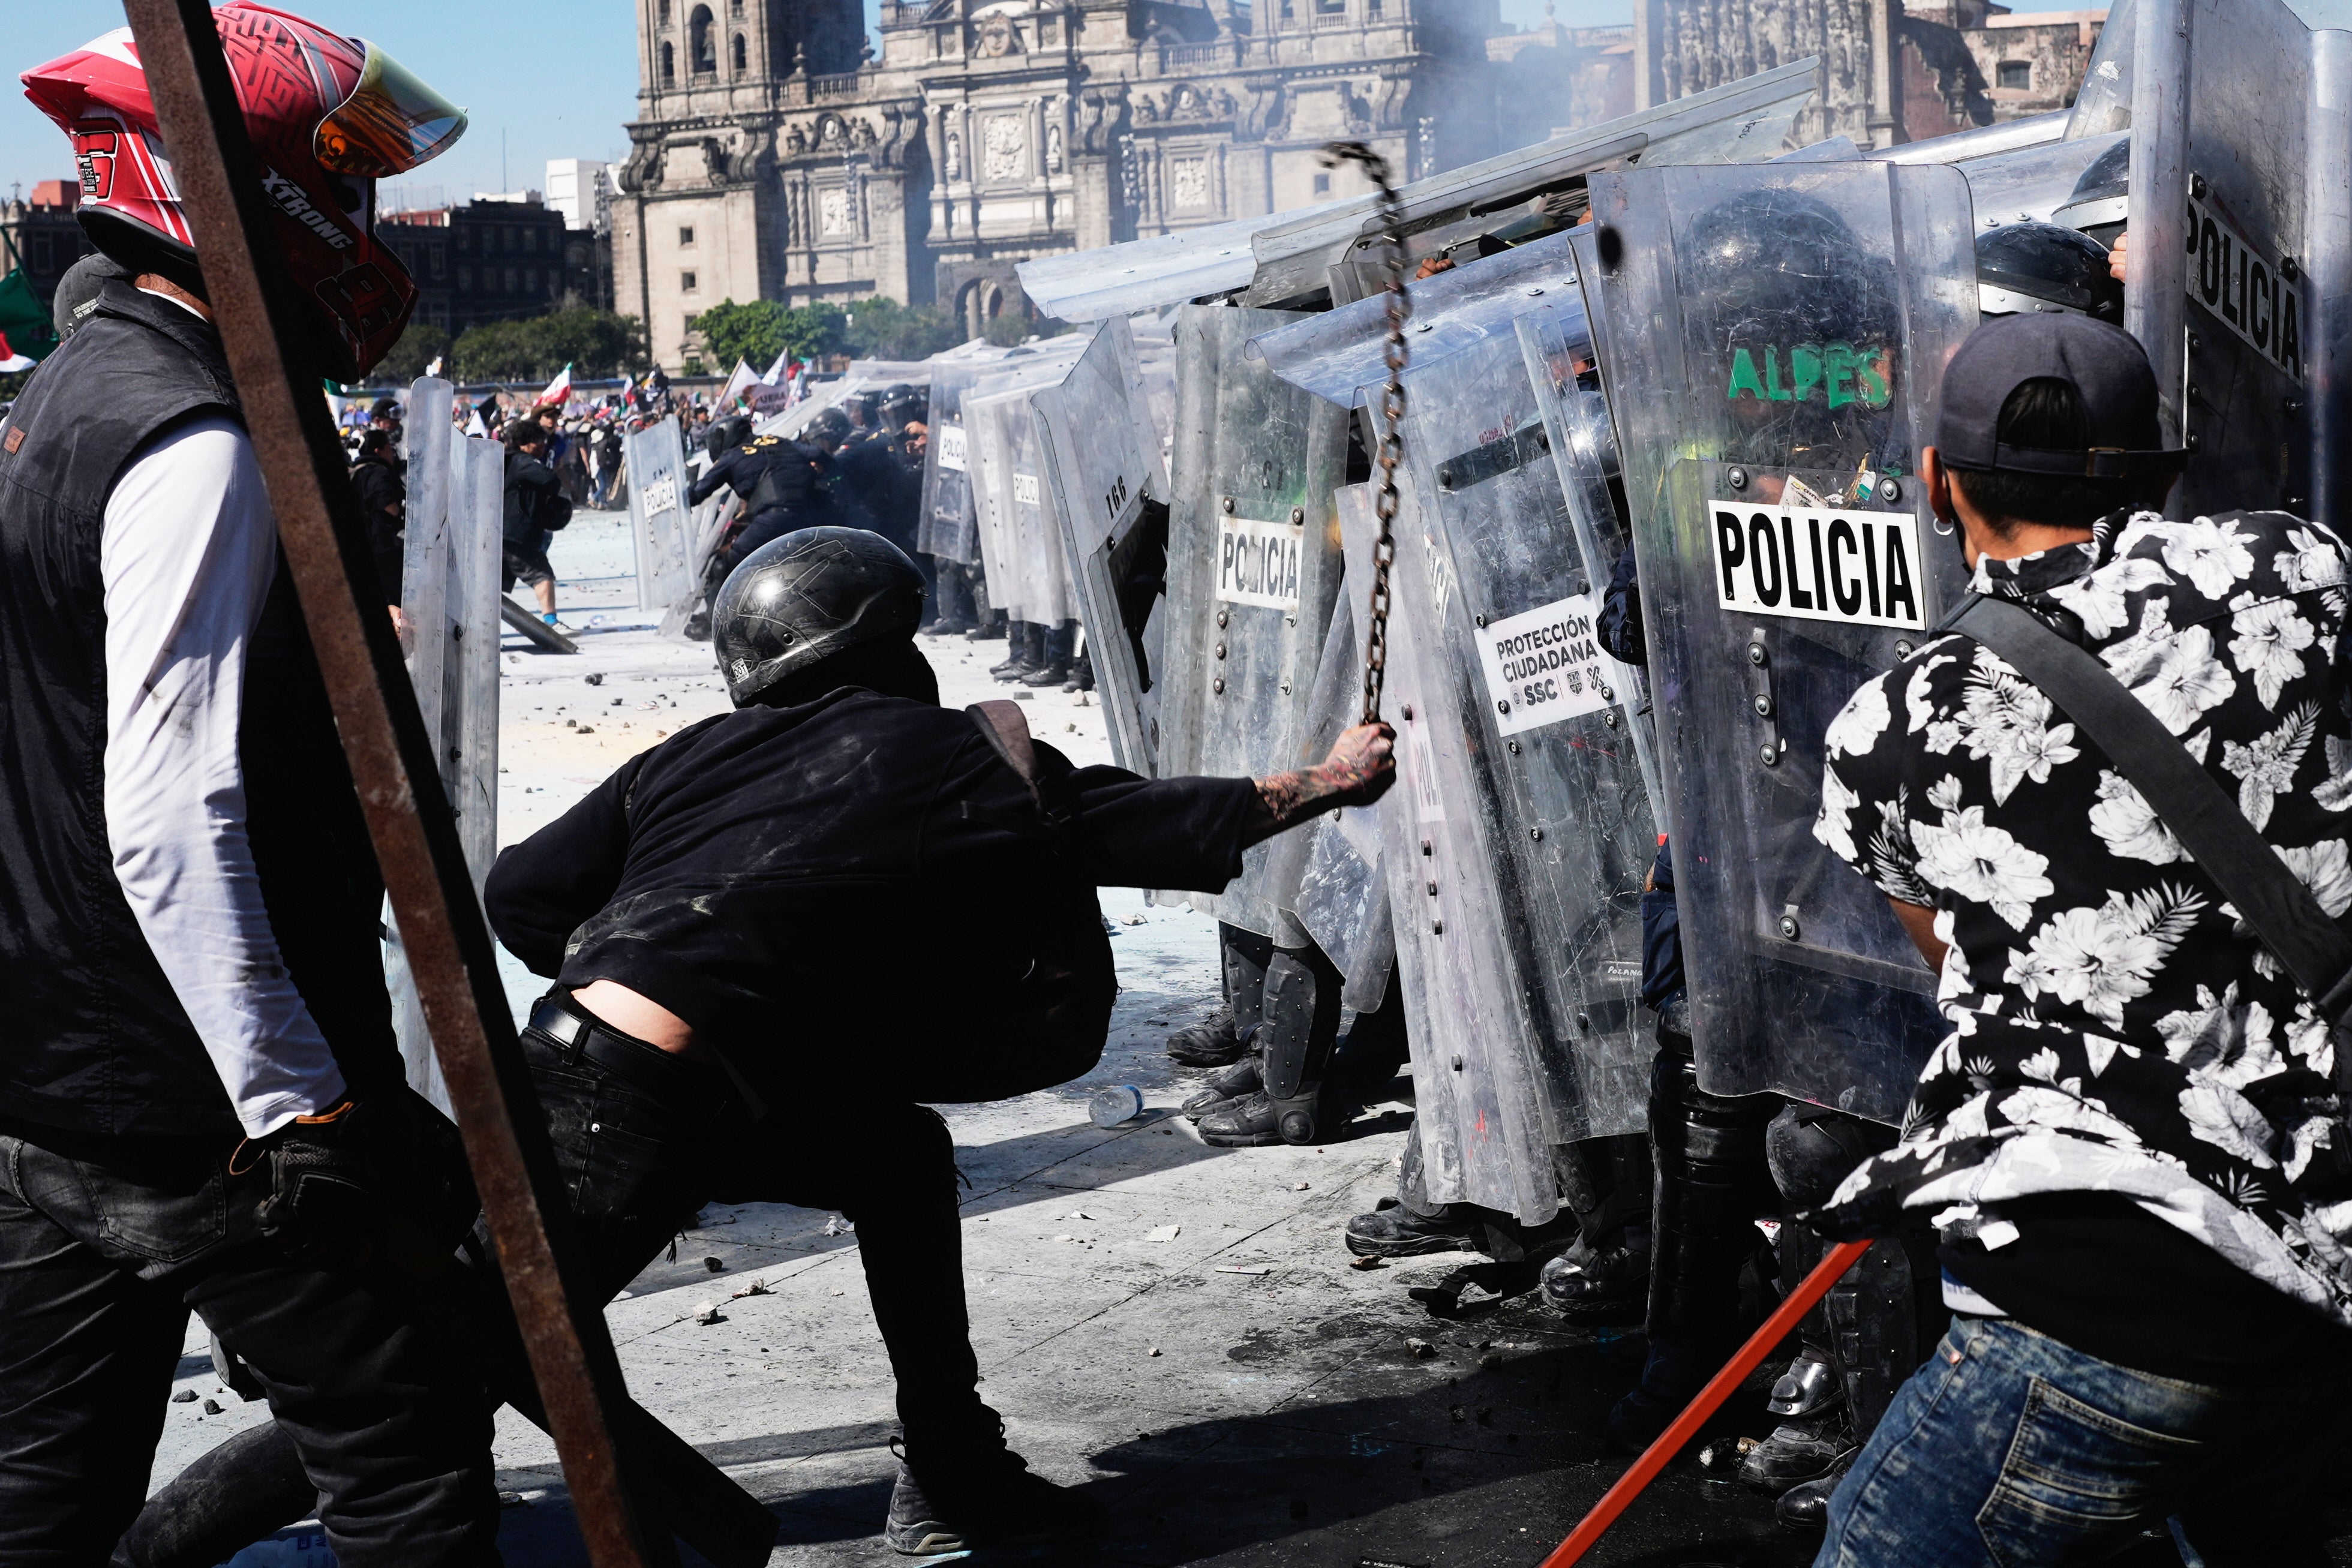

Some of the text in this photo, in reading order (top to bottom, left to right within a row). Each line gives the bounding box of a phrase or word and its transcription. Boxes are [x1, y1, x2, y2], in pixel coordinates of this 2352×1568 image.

[262, 165, 354, 249] XTRONG
[1728, 339, 1892, 410] ALPES
[647, 486, 673, 510] POLICIA
[1106, 474, 1127, 520] 166
[1716, 510, 1918, 621] POLICIA
[1496, 614, 1591, 660] PROTECCIÓN
[1503, 639, 1599, 683] CIUDADANA
[1524, 678, 1558, 706] SSC
